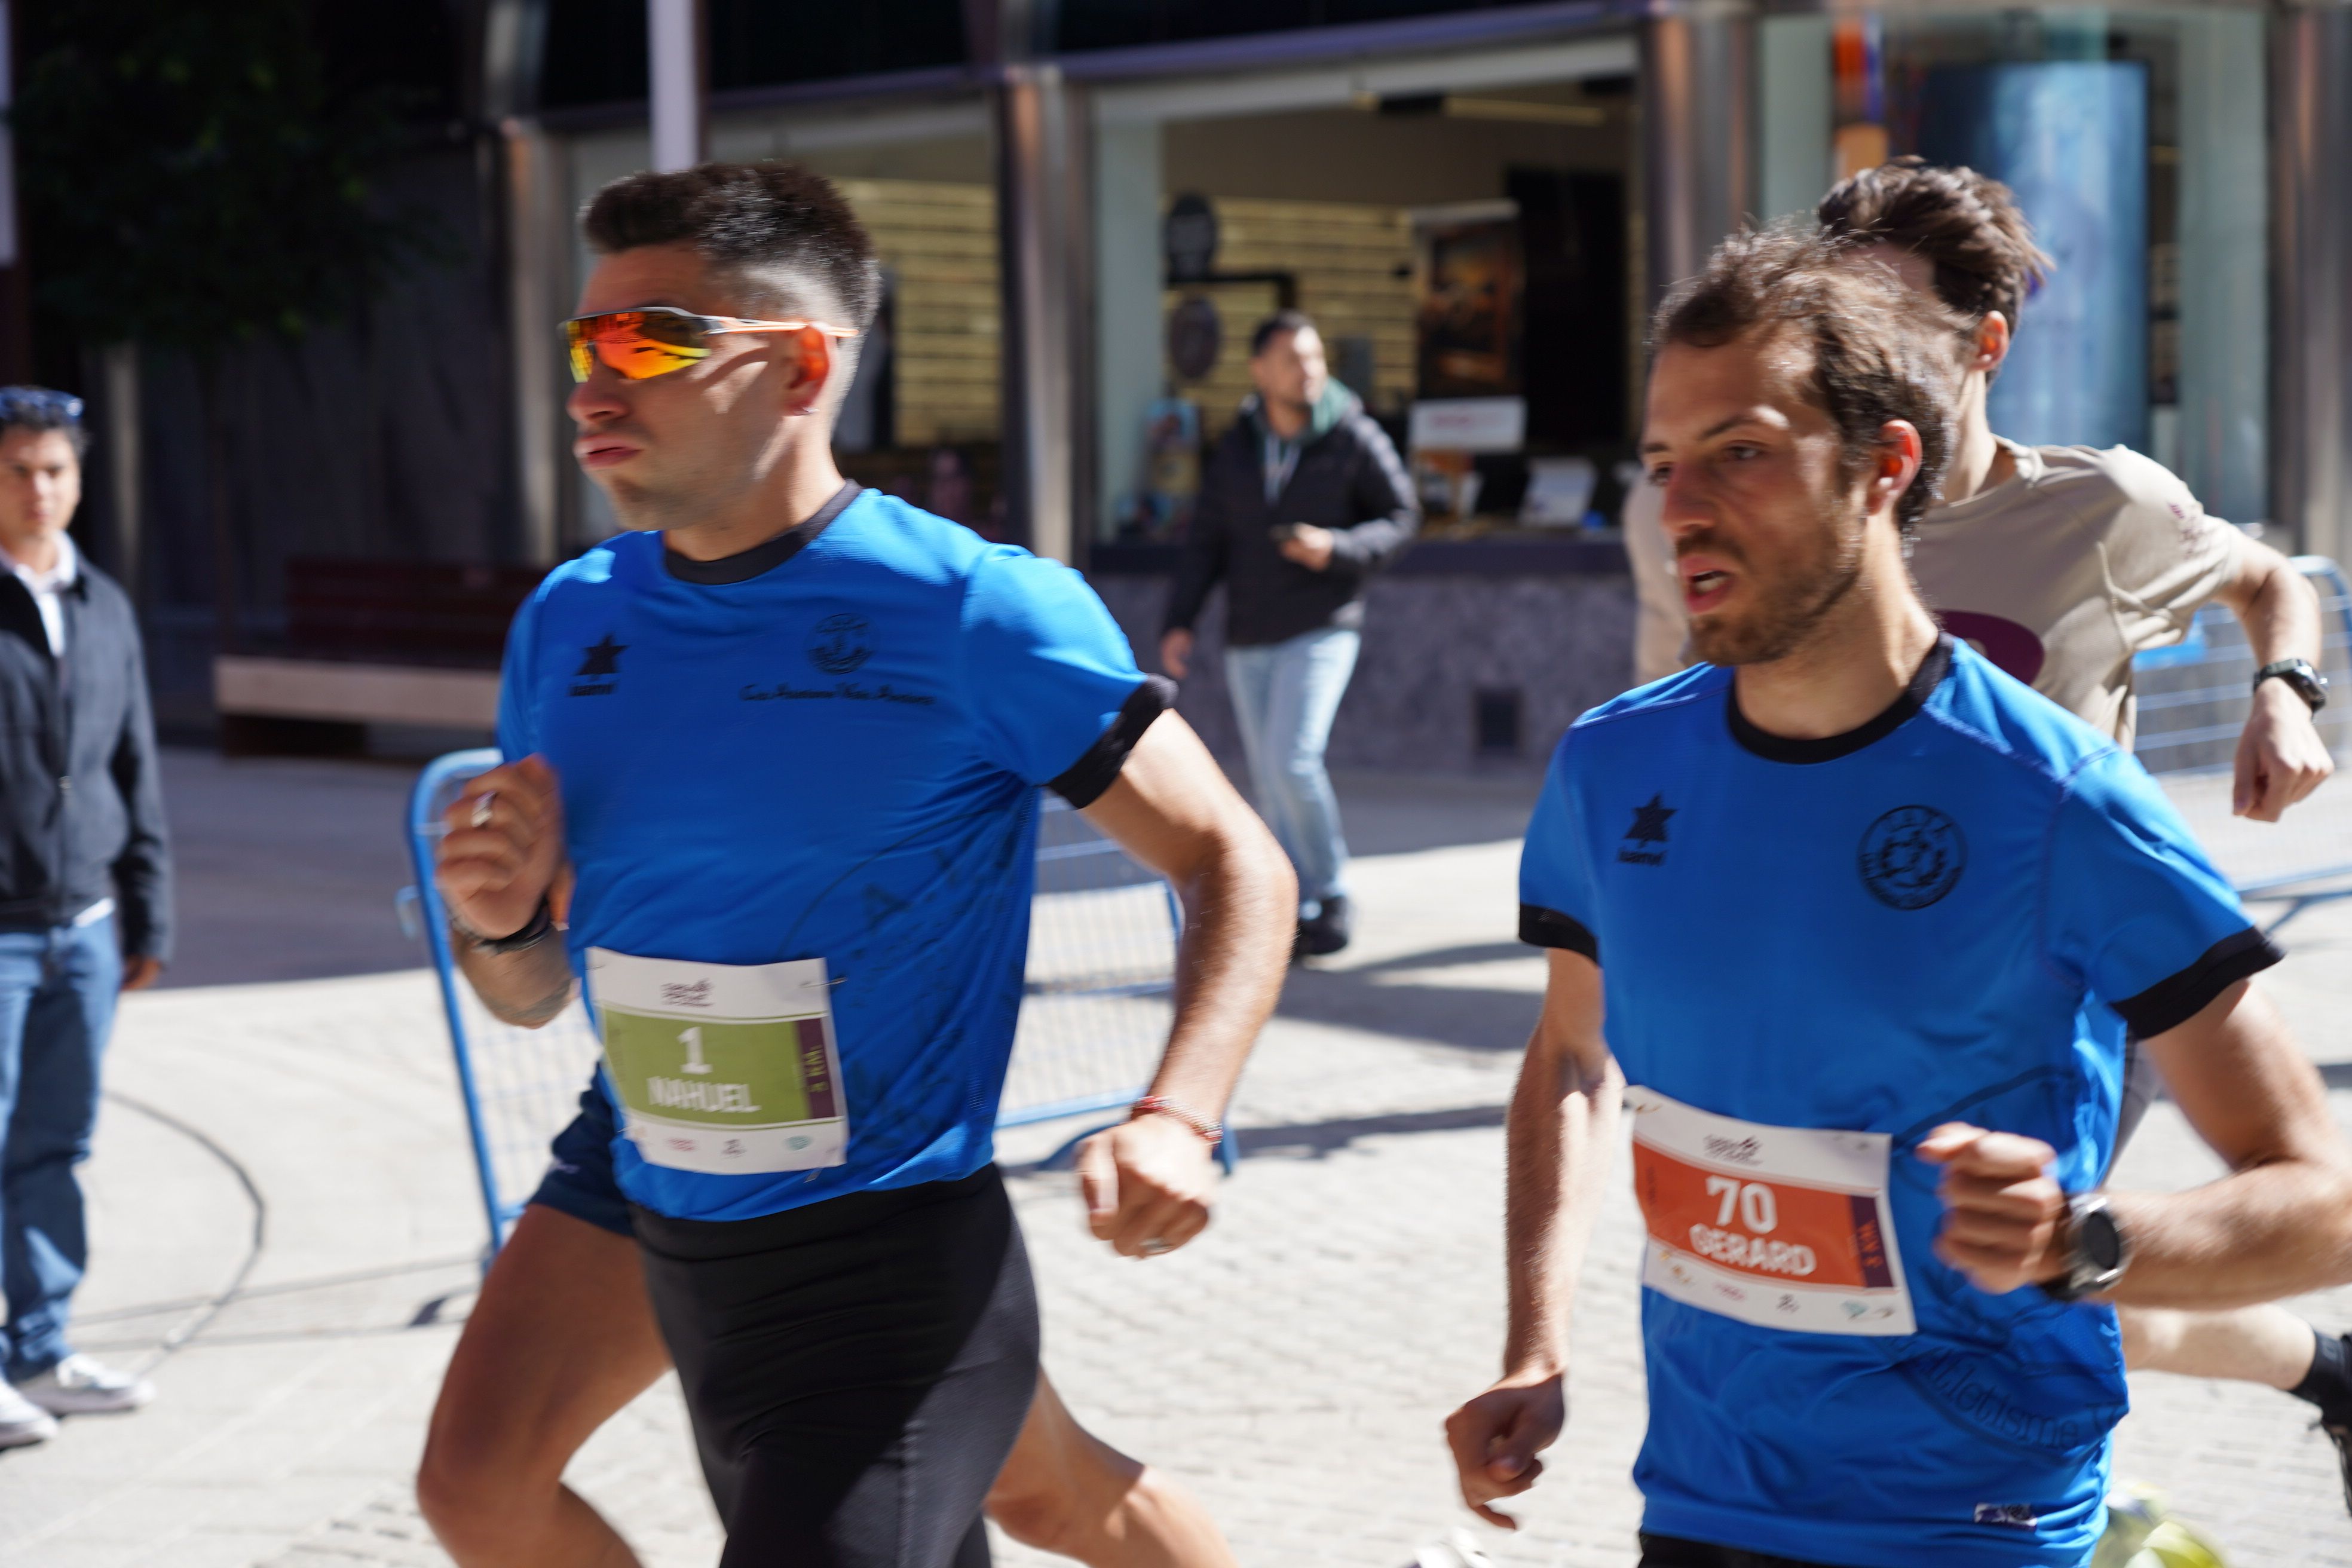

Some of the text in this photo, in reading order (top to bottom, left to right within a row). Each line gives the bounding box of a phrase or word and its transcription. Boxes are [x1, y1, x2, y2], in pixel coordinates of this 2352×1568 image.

[676, 1027, 713, 1074] 1
[647, 1076, 761, 1113] NAHUEL
[1705, 1175, 1778, 1234] 70
[1689, 1223, 1817, 1275] GERARD
